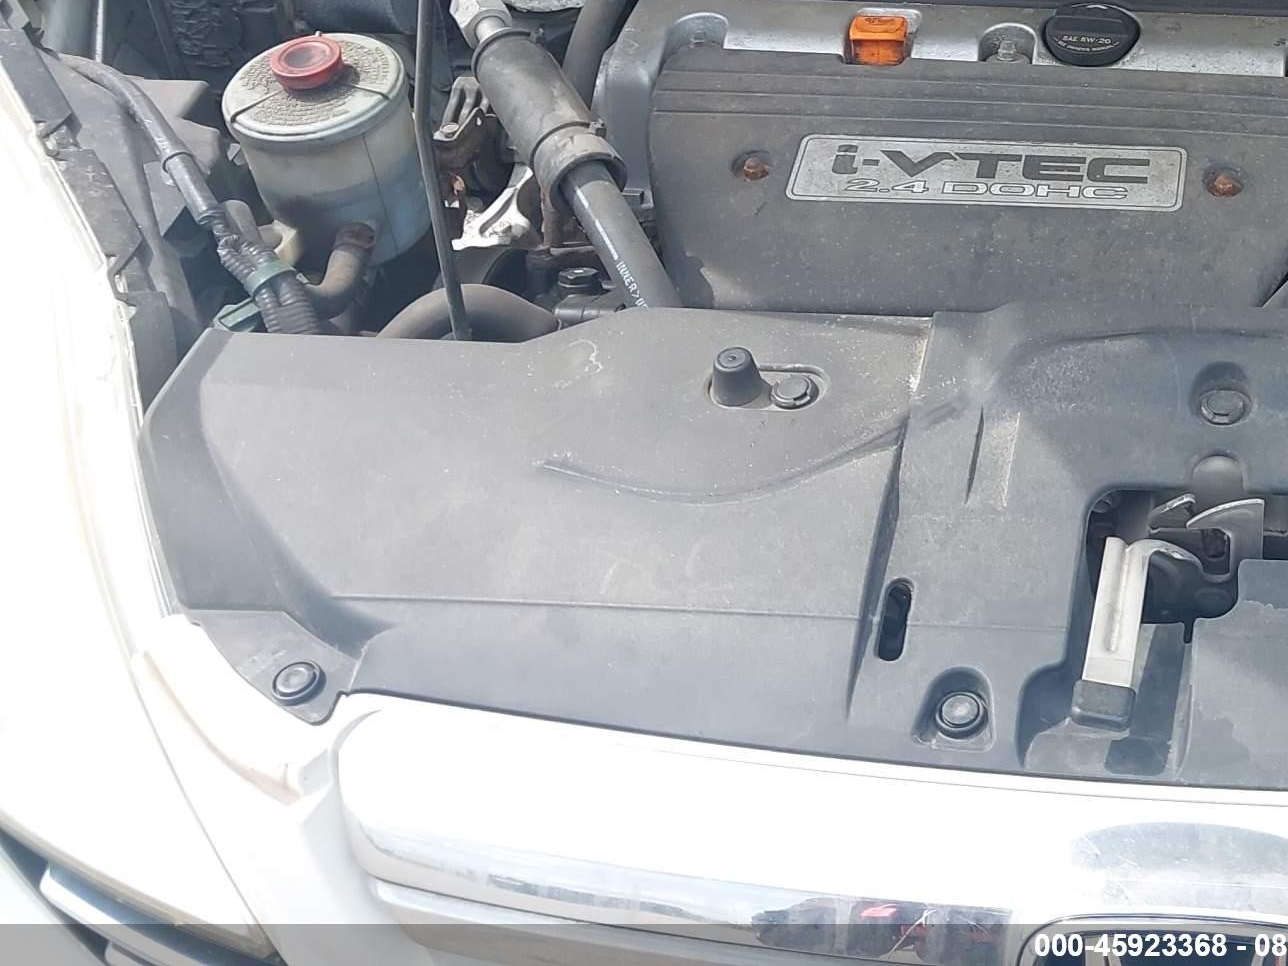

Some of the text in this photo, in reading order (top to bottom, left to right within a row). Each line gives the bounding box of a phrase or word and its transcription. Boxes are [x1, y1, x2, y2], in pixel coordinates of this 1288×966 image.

[831, 144, 1151, 185] i-VTEC
[844, 178, 1129, 199] 2.4 DOHC
